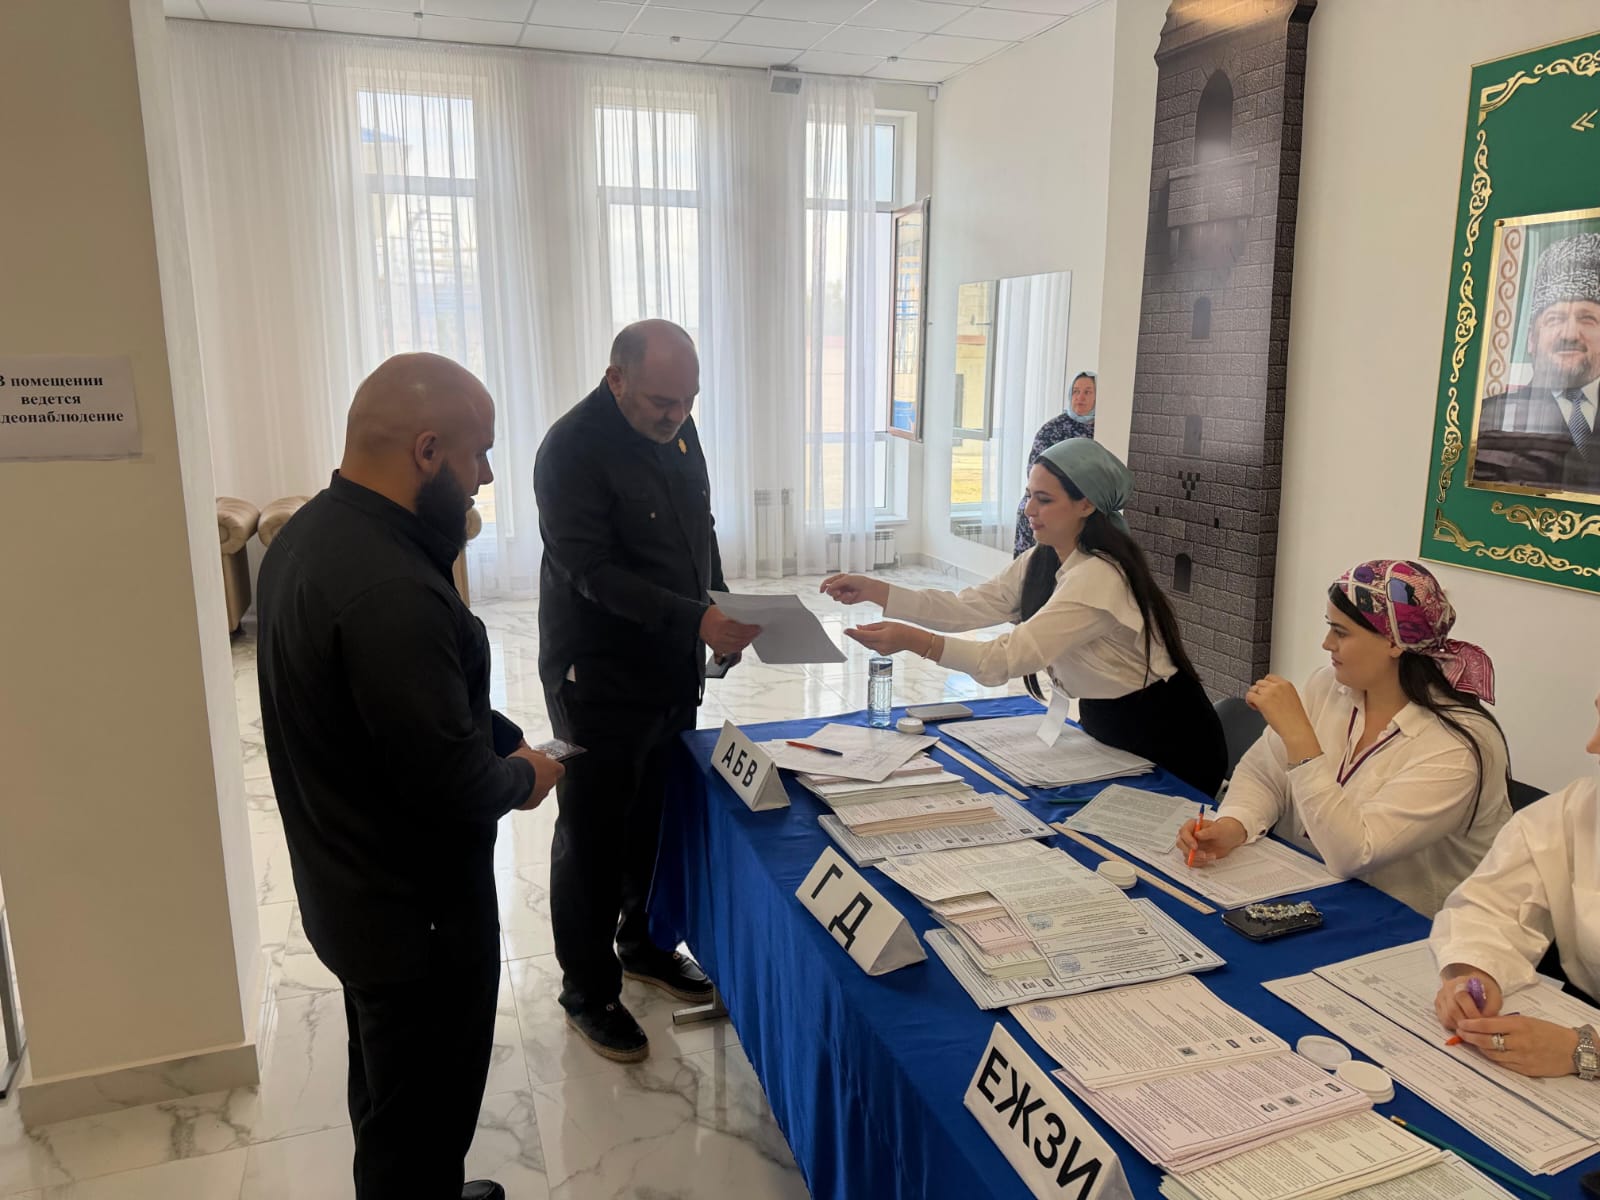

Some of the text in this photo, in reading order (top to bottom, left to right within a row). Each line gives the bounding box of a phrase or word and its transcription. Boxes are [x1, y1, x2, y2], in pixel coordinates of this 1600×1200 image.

[11, 376, 104, 388] помещении
[21, 395, 81, 406] ведется
[0, 411, 124, 424] деонаблюдение
[721, 741, 758, 788] АБВ
[976, 1045, 1103, 1200] ЕЖЗИ
